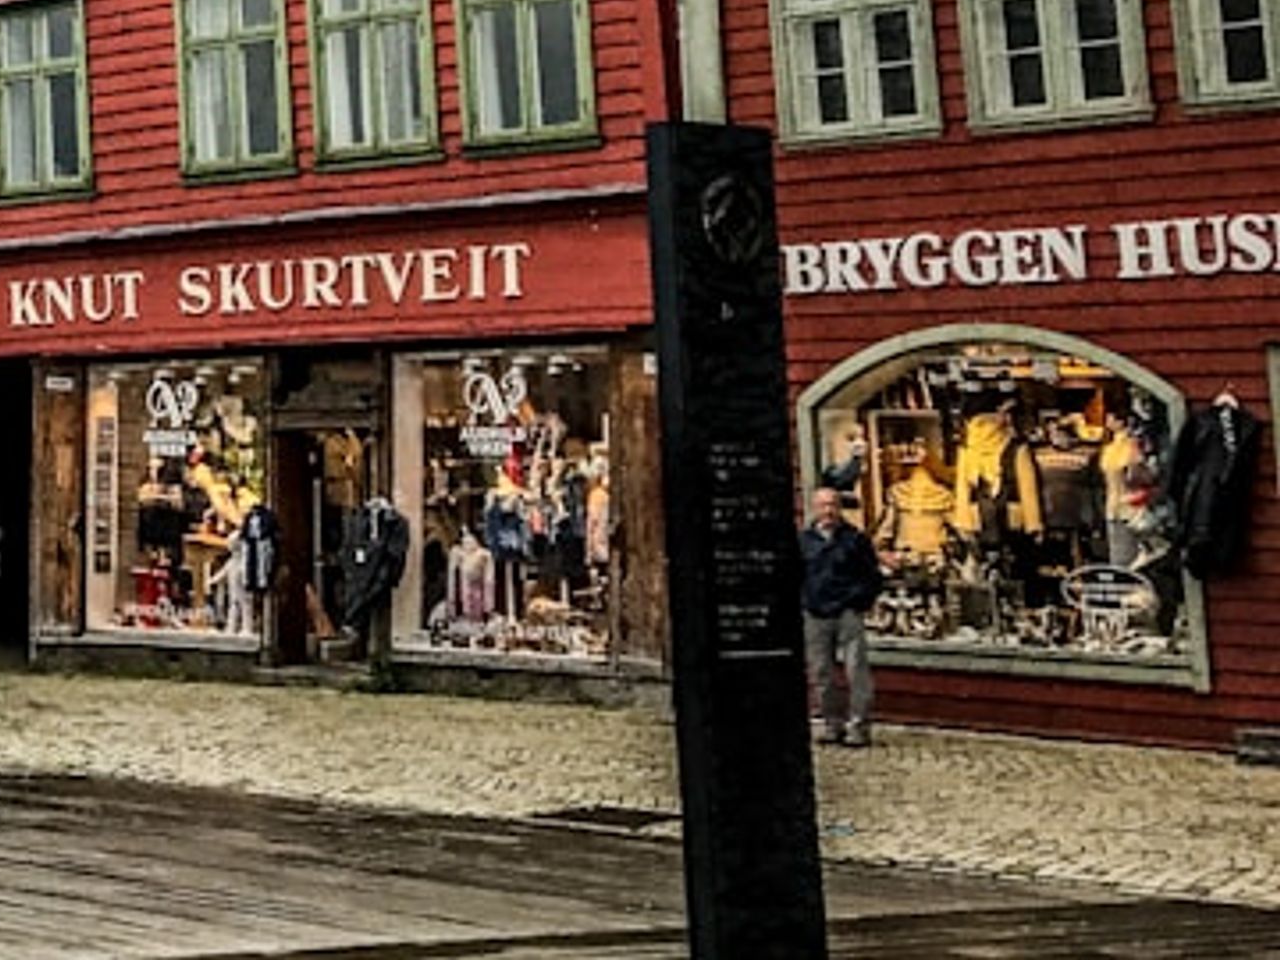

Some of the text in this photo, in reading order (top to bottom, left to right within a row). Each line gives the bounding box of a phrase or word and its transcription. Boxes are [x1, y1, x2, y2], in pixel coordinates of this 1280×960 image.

[8, 242, 531, 327] KNUT SKURTVEIT
[780, 225, 1088, 296] BRYGGEN
